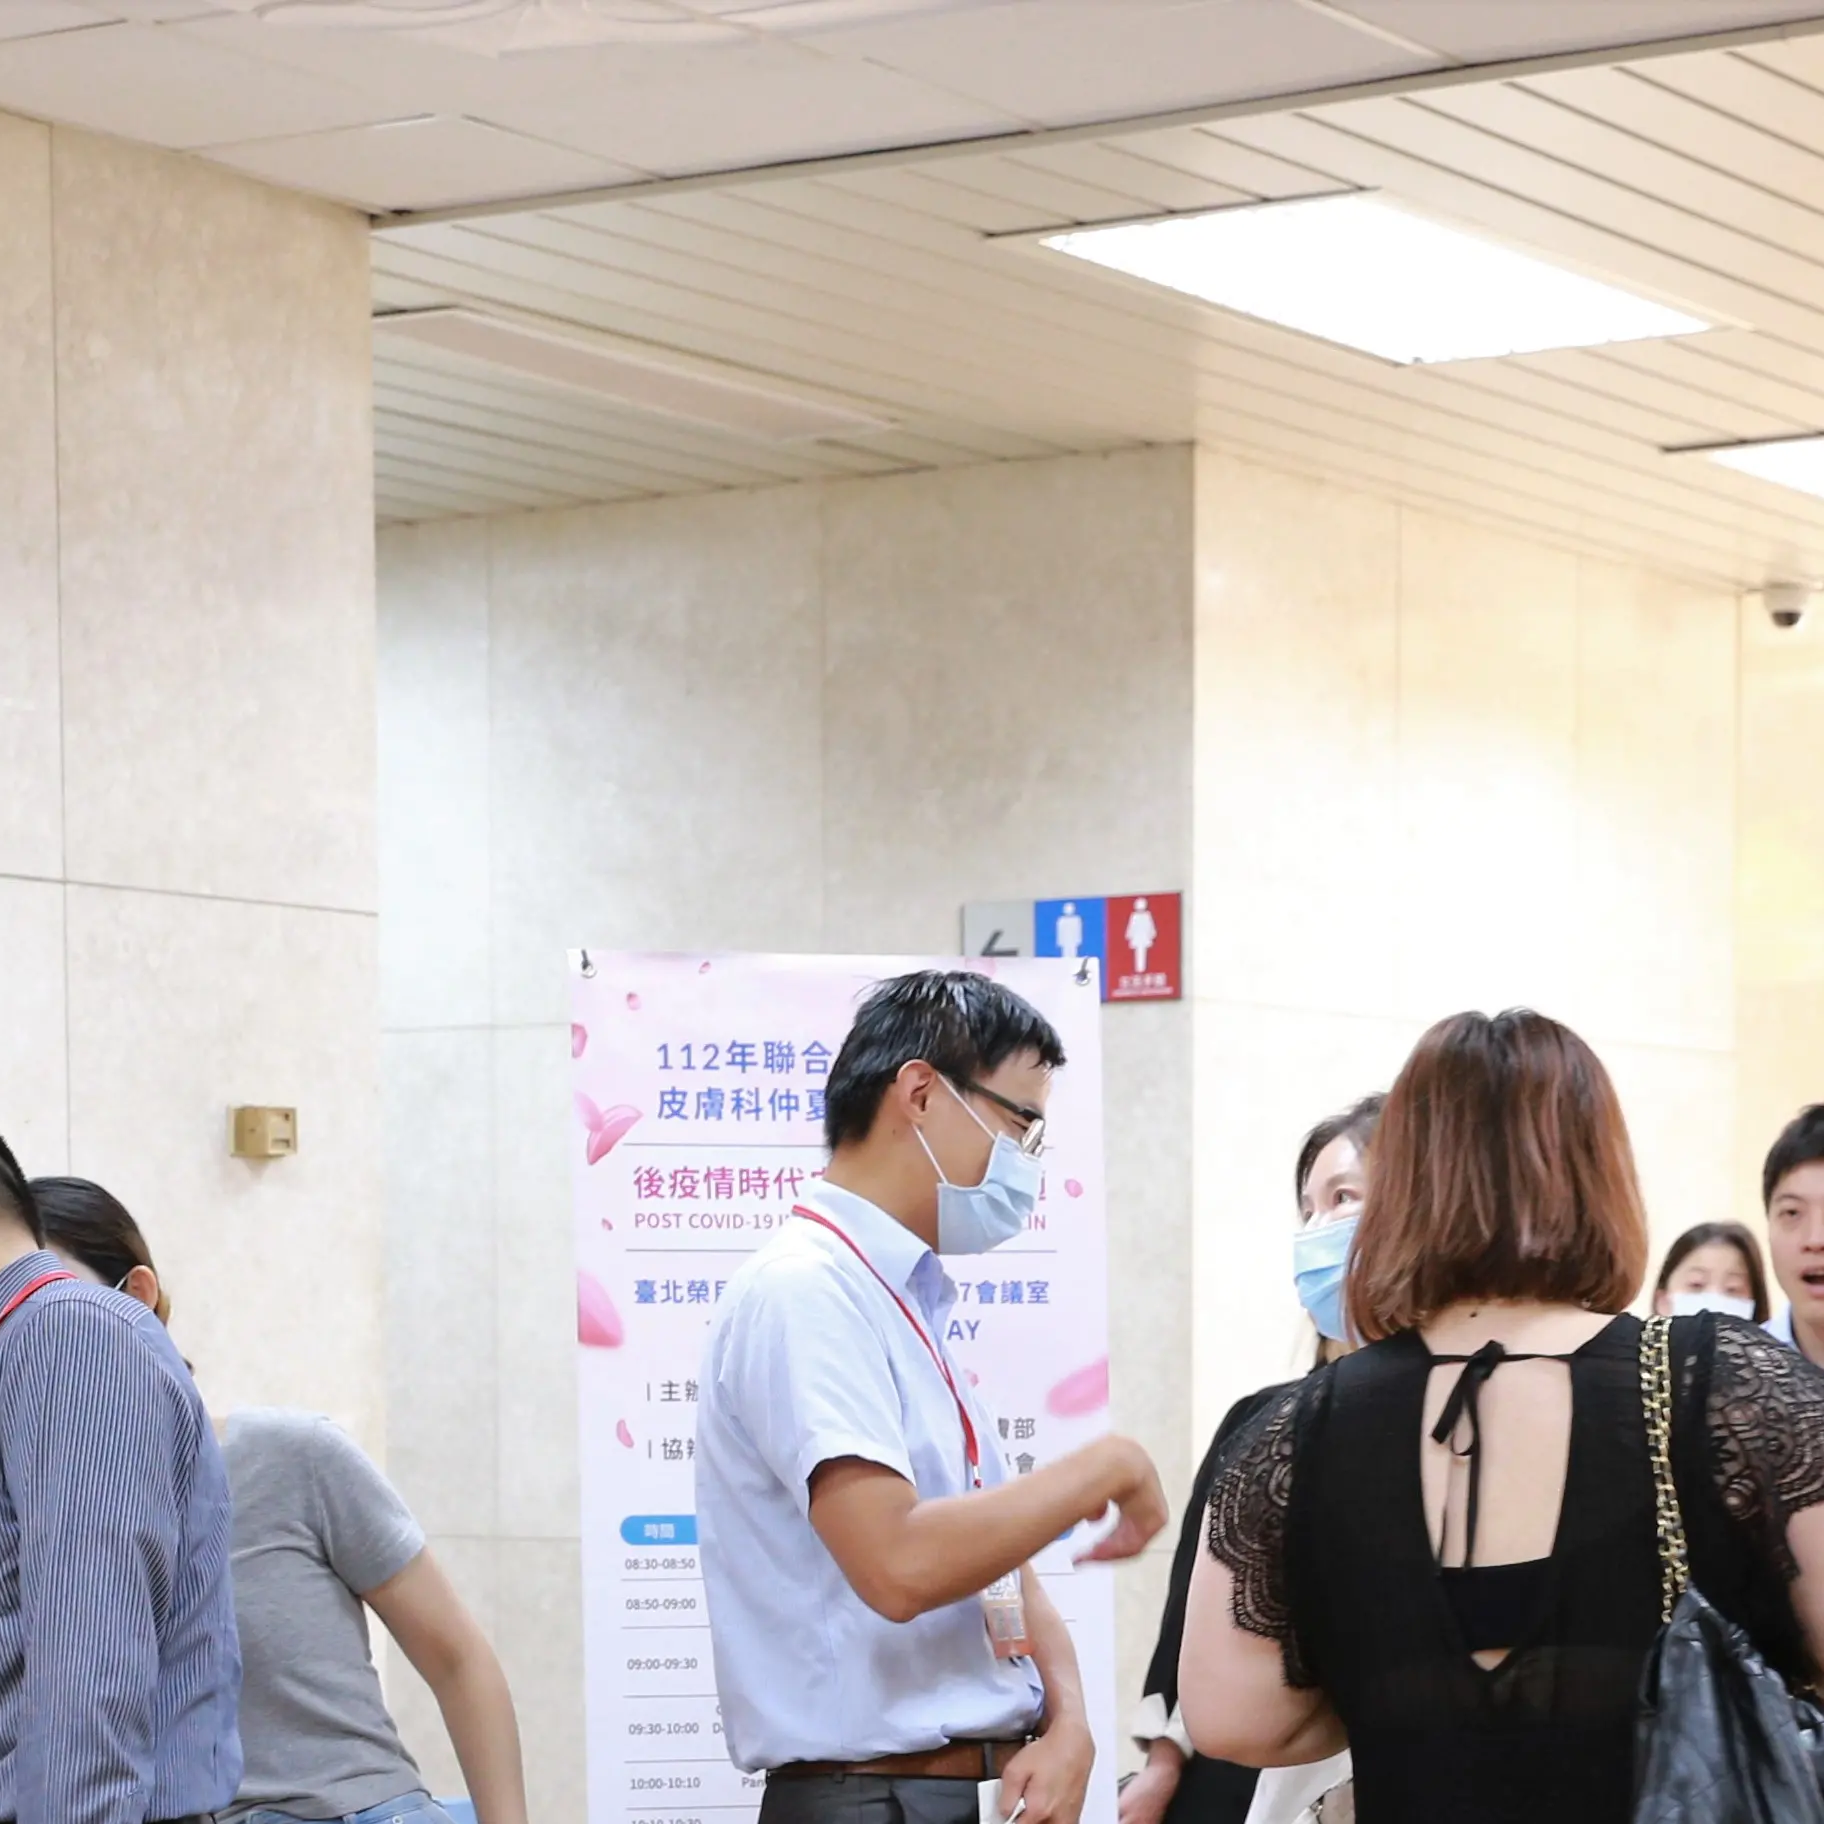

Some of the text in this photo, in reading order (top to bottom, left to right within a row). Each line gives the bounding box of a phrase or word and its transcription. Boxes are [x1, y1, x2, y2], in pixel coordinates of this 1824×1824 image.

[633, 1166, 826, 1201] 後疫情時代
[634, 1212, 683, 1229] POST
[688, 1212, 773, 1230] COVID-19
[625, 1557, 696, 1570] 08:30-08:50
[626, 1598, 697, 1611] 08:50-09:00
[627, 1657, 698, 1670] 09:00-09:30
[628, 1722, 699, 1735] 09:30-10:00
[630, 1777, 701, 1790] 10:00-10:10
